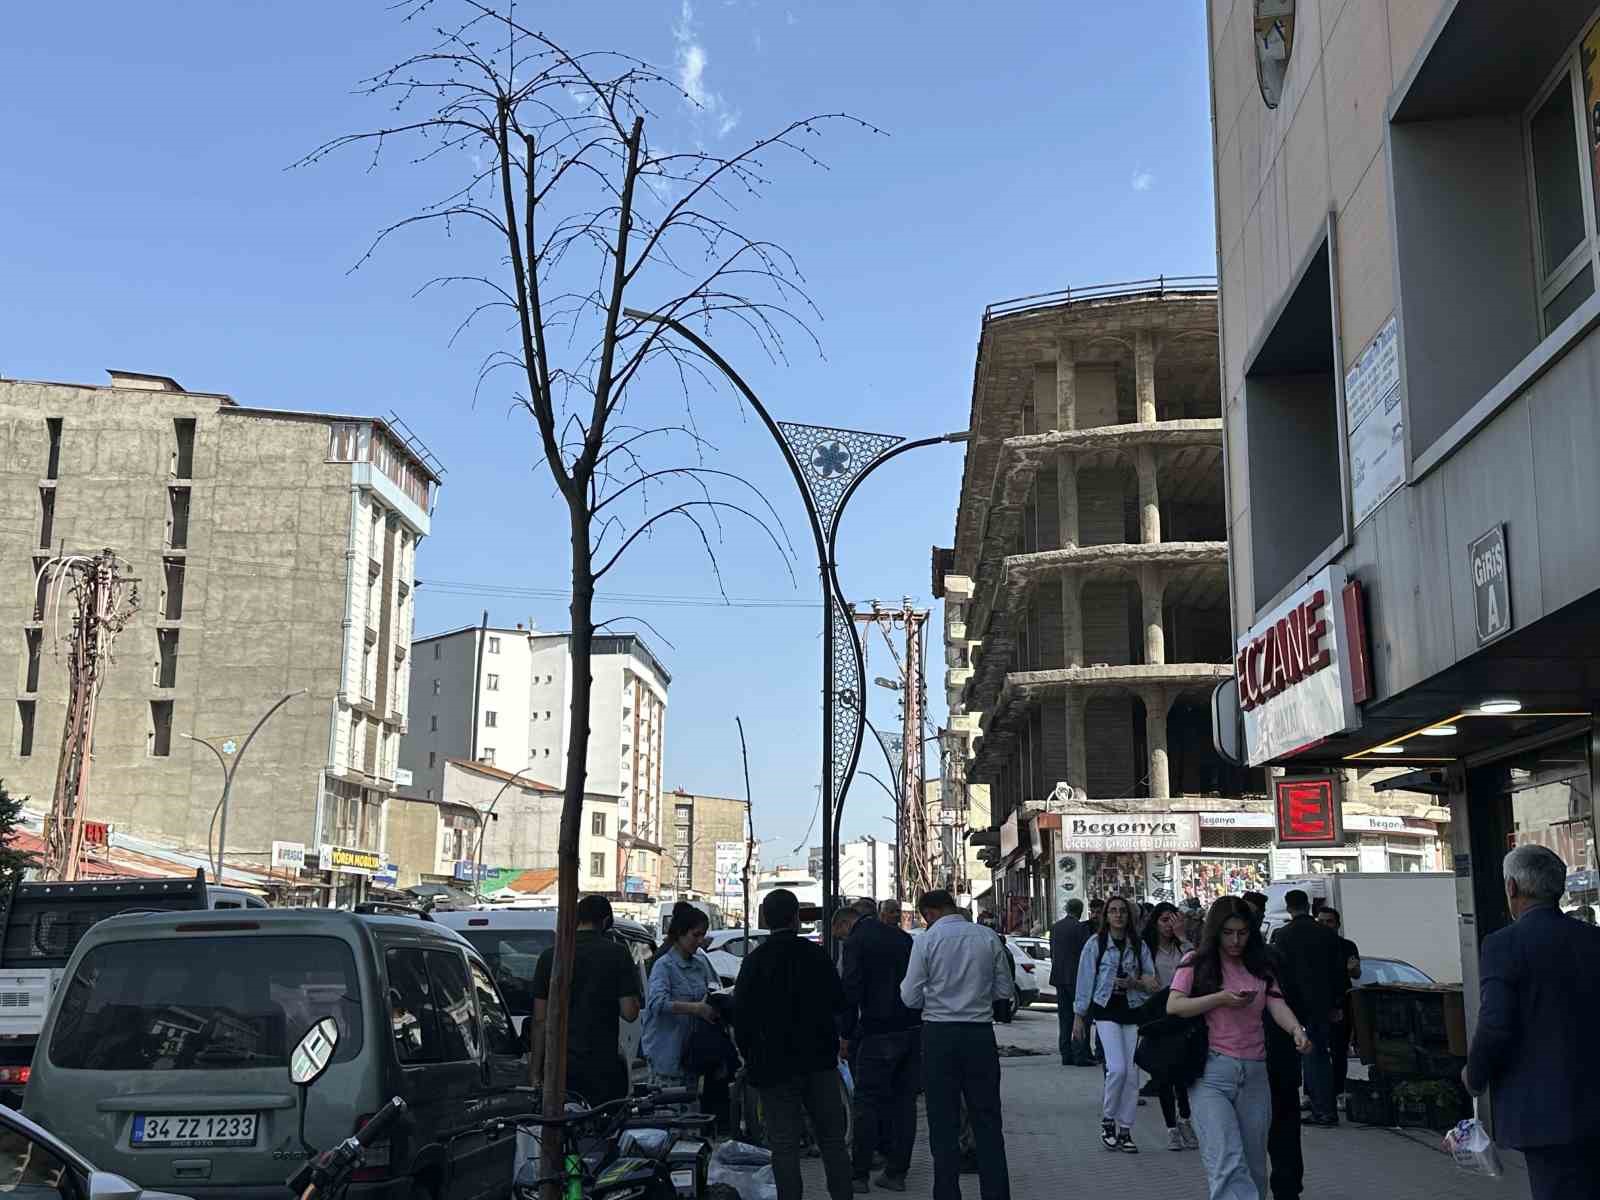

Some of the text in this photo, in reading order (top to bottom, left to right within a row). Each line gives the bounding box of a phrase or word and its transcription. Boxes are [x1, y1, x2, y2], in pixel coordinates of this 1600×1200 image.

[1487, 583, 1501, 634] A
[1236, 589, 1330, 712] ECZANE
[1072, 819, 1178, 835] Begonya
[1288, 789, 1324, 832] E
[147, 1118, 252, 1139] 34 ZZ 1233
